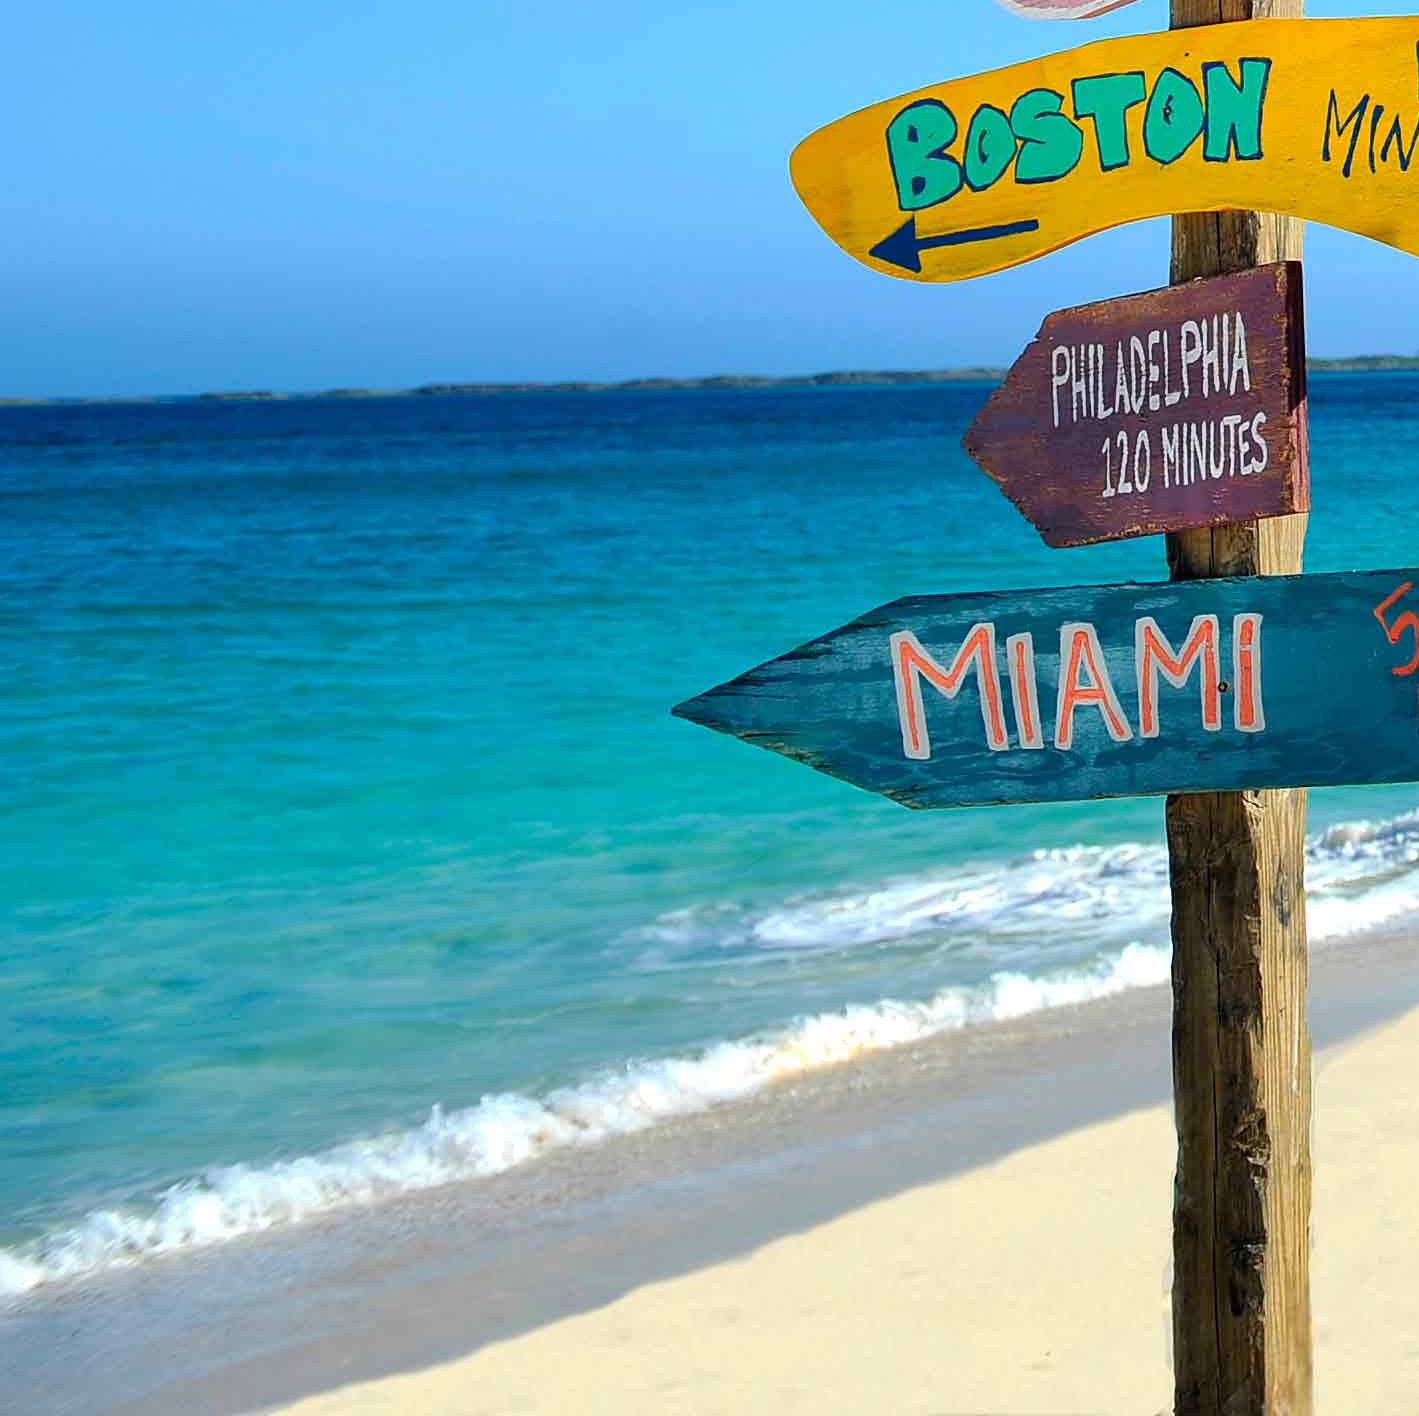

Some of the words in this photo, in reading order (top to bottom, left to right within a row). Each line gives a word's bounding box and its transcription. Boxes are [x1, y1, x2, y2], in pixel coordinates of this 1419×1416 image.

[886, 57, 1272, 211] BOSTON
[1051, 311, 1250, 428] PHILADELPHIA
[1101, 430, 1150, 498] 120
[1161, 411, 1268, 489] MINUTES
[889, 612, 1267, 760] MIAMI
